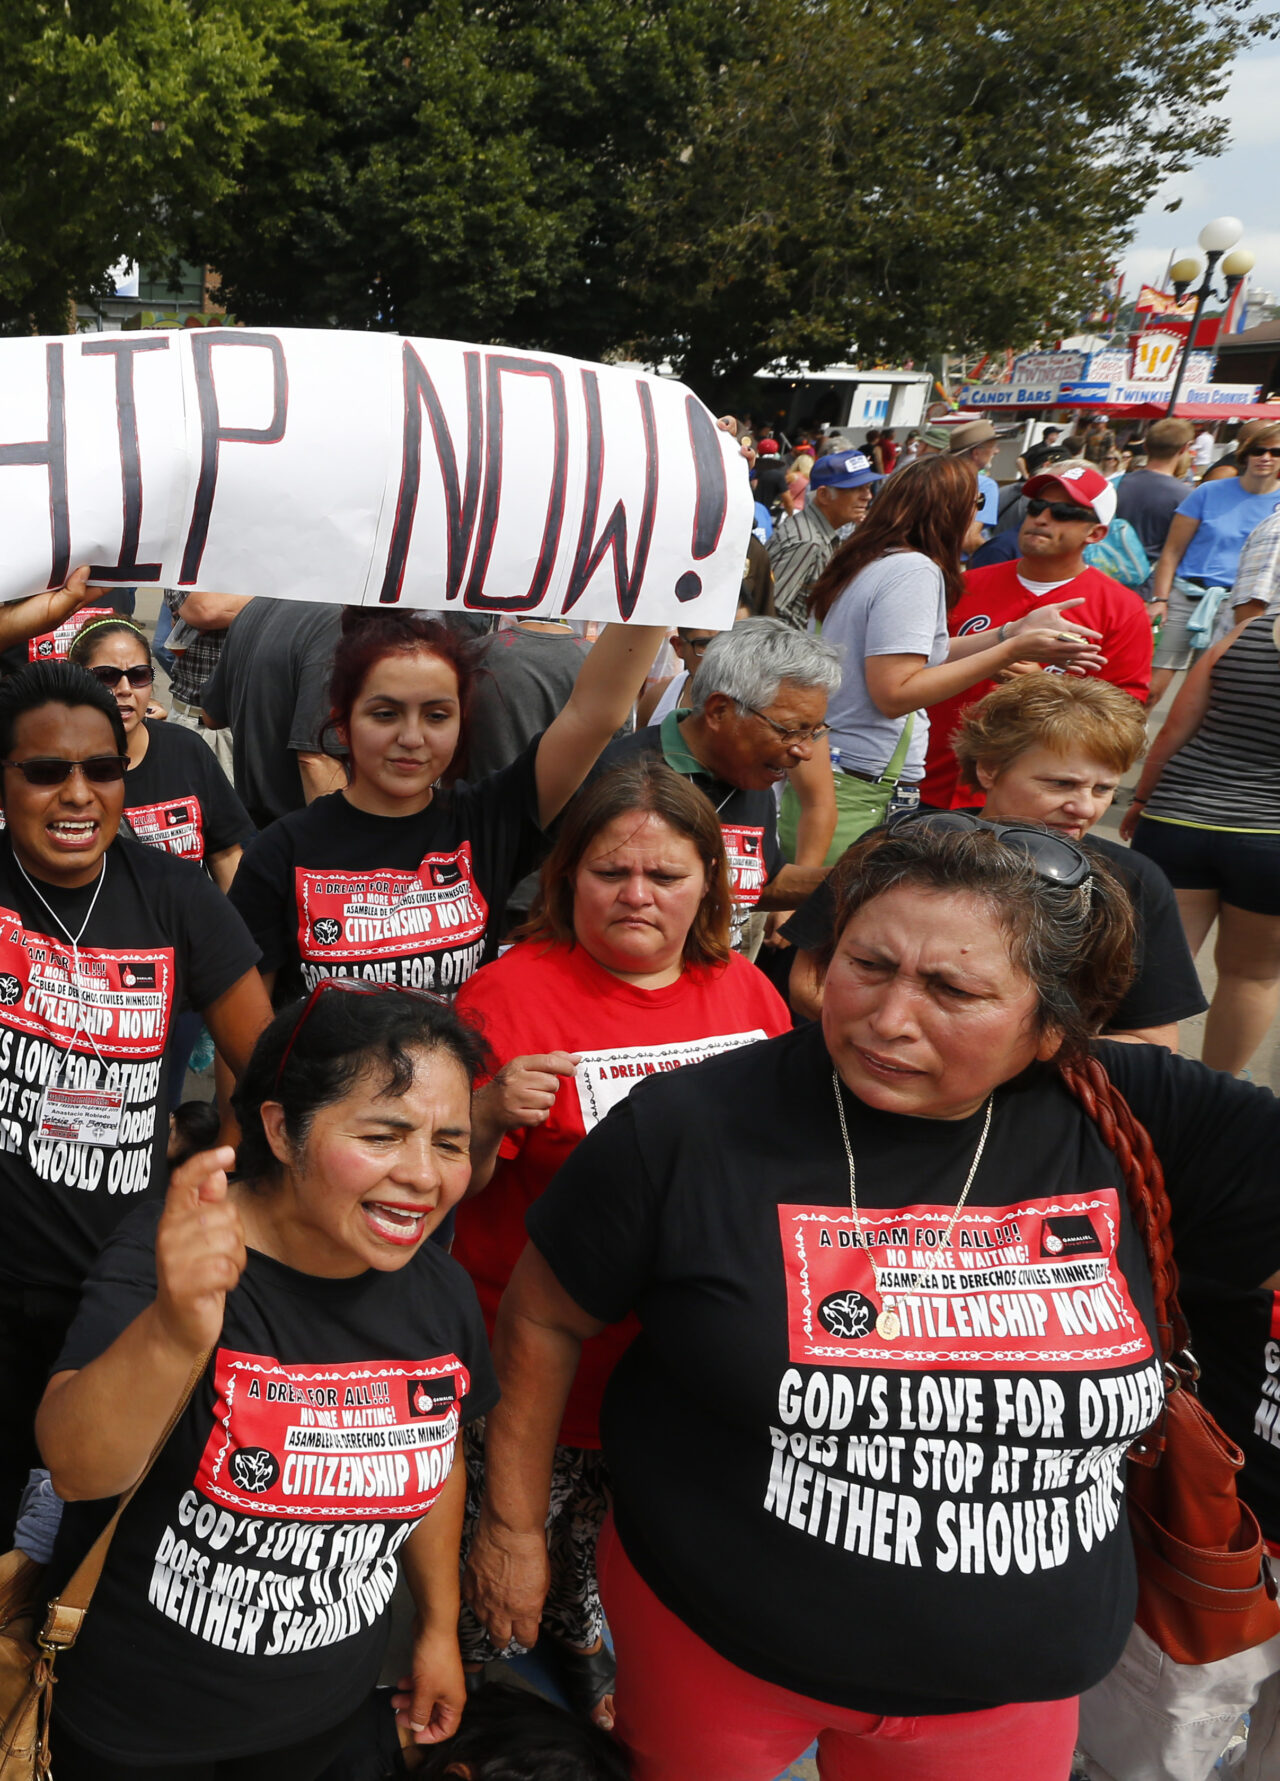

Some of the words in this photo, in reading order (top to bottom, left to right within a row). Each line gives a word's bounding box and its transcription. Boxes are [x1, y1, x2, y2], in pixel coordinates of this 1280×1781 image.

[972, 390, 1013, 404] CANDY
[1017, 388, 1052, 403] BARS
[1116, 387, 1171, 402] TWINKIE
[380, 338, 729, 622] NOW!
[169, 834, 197, 855] NOW!
[315, 882, 323, 894] A
[326, 883, 365, 895] DREAM
[369, 881, 389, 893] FOR
[351, 893, 364, 904] NO
[366, 894, 389, 906] MORE
[346, 905, 378, 917] ASAMBLEA
[379, 906, 388, 916] DE
[416, 891, 437, 904] CIVILES
[344, 907, 432, 943] CITIZENSHIP
[435, 897, 477, 929] NOW!
[10, 930, 19, 943] A
[43, 965, 69, 982] MORE
[401, 956, 436, 989] FOR
[24, 985, 114, 1037] CITIZENSHIP
[118, 1008, 162, 1040] NOW!
[99, 992, 124, 1006] CIVILES
[126, 995, 161, 1007] MINNESOTA
[14, 1035, 63, 1086] LOVE
[64, 1053, 101, 1089] FOR
[105, 1057, 163, 1104] OTHERS
[599, 1066, 608, 1081] A
[611, 1061, 656, 1079] DREAM
[660, 1059, 681, 1073] FOR
[51, 1109, 83, 1117] Anastacio
[119, 1104, 157, 1145] ORDER
[28, 1130, 105, 1192] SHOULD
[107, 1143, 154, 1195] OURS
[820, 1227, 832, 1248] A
[838, 1227, 909, 1249] DREAM
[915, 1227, 952, 1249] FOR
[959, 1223, 1023, 1249] ALL!!!
[886, 1248, 908, 1268] NO
[912, 1249, 955, 1270] MORE
[962, 1245, 1030, 1270] WAITING!
[880, 1271, 939, 1290] ASAMBLEA
[941, 1270, 957, 1290] DE
[959, 1268, 1017, 1289] DERECHOS
[1018, 1266, 1051, 1286] CIVILES
[1051, 1283, 1126, 1337] NOW!
[248, 1379, 261, 1399] A
[307, 1384, 339, 1407] FOR
[343, 1382, 390, 1408] ALL!!!
[777, 1367, 889, 1432] GOD'S
[899, 1374, 985, 1434] LOVE
[992, 1377, 1066, 1440] FOR
[1078, 1359, 1166, 1440] OTHERS
[300, 1407, 315, 1426] NO
[342, 1406, 398, 1428] WAITING!
[288, 1430, 334, 1448] ASAMBLEA
[342, 1430, 387, 1450] DERECHOS
[388, 1428, 417, 1448] CIVILES
[769, 1425, 839, 1468] DOES
[847, 1434, 907, 1484] NOT
[912, 1438, 985, 1494] STOP
[990, 1445, 1031, 1495] AT
[1031, 1446, 1081, 1491] THE
[282, 1453, 410, 1498] CITIZENSHIP
[763, 1449, 922, 1568] NEITHER
[935, 1497, 1070, 1576] SHOULD
[178, 1489, 264, 1555] GOD'S
[255, 1521, 334, 1571] LOVE
[325, 1523, 387, 1571] FOR
[154, 1525, 210, 1584] DOES
[210, 1562, 261, 1605] NOT
[148, 1561, 266, 1656] NEITHER
